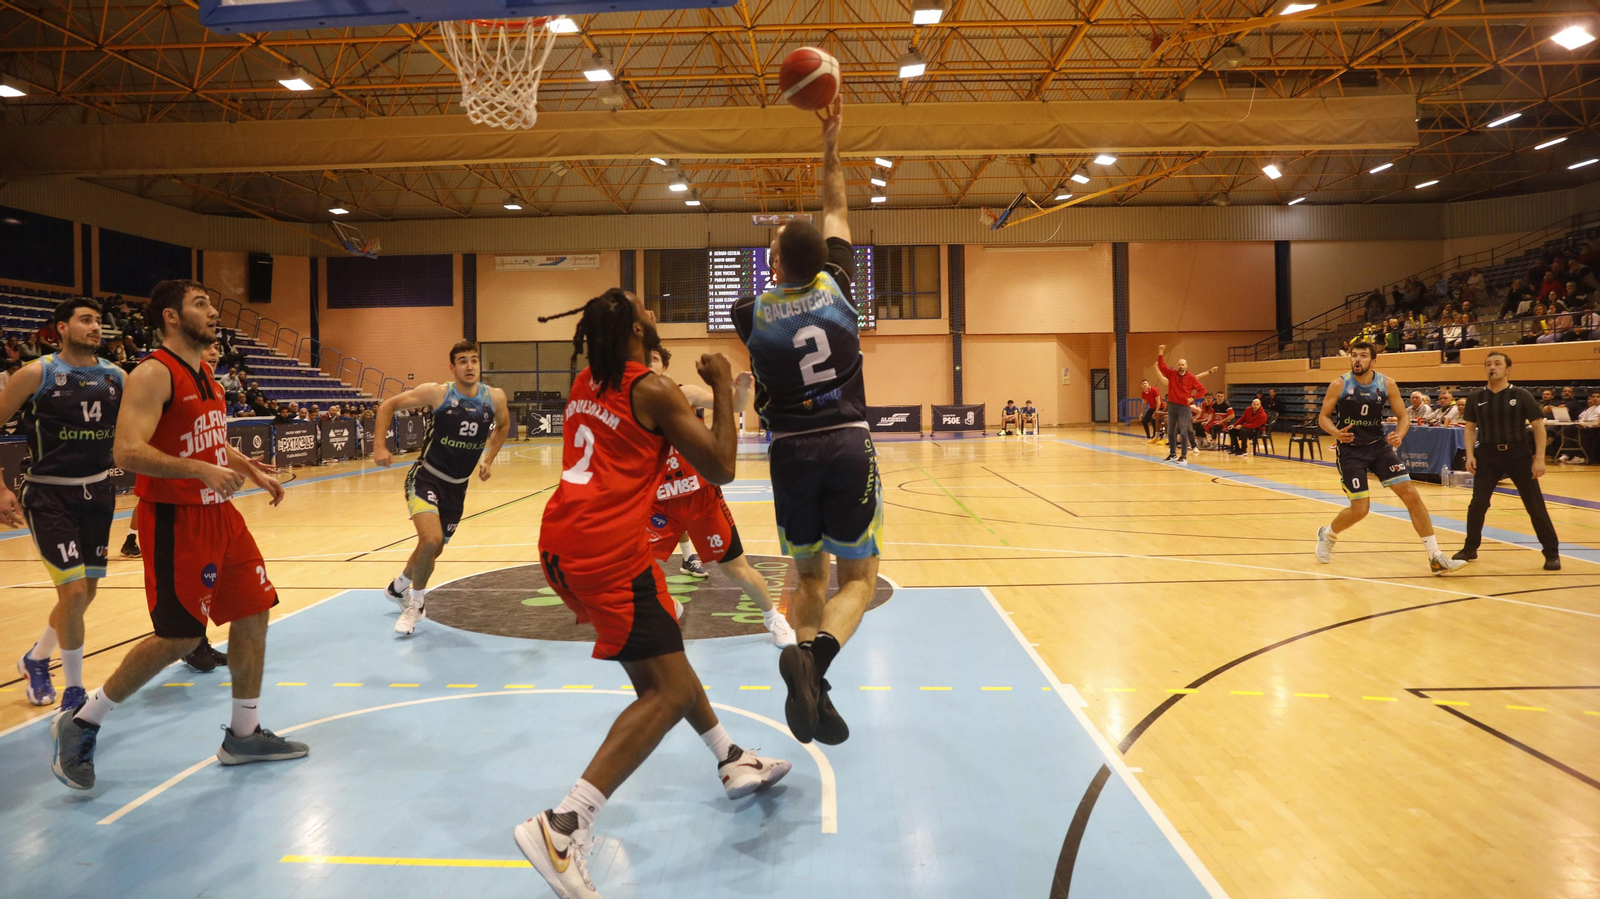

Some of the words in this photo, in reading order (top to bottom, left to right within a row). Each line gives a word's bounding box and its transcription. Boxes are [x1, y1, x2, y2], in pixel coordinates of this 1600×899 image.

[762, 290, 835, 323] BALASTEGUI
[792, 325, 837, 386] 2
[80, 401, 102, 422] 14
[1360, 404, 1369, 416] 0
[459, 420, 479, 437] 29
[942, 417, 960, 425] PSOE
[215, 447, 229, 468] 10
[561, 424, 595, 485] 2
[1352, 477, 1361, 489] 0
[57, 540, 80, 563] 14
[706, 534, 724, 548] 28
